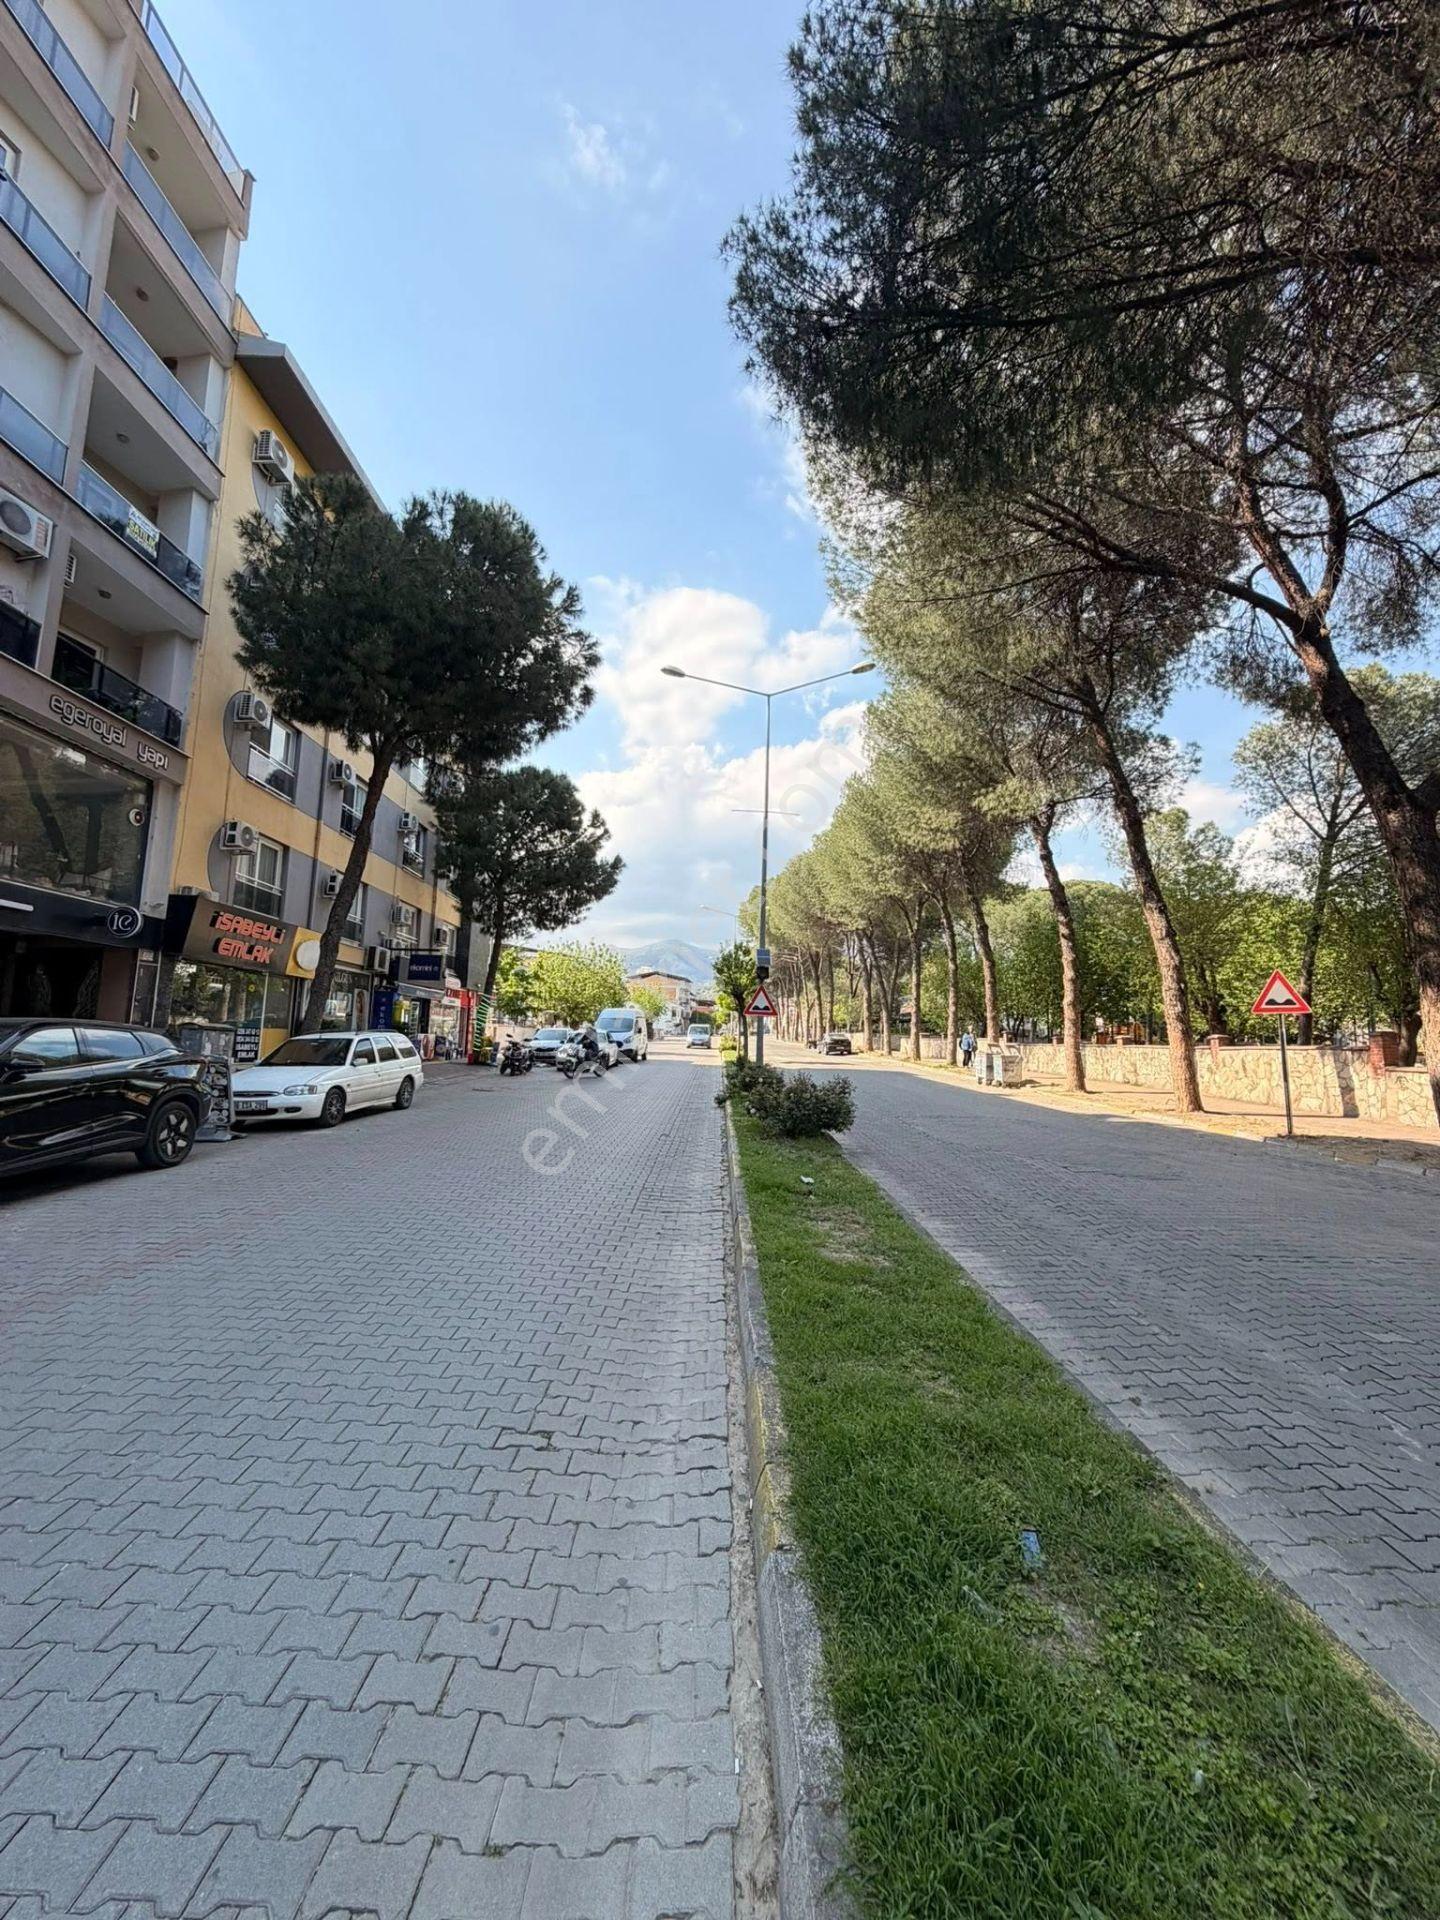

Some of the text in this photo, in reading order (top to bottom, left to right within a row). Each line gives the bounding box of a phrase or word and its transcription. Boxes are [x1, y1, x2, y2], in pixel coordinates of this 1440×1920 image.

[50, 695, 169, 769] egeroyal yapı
[217, 937, 275, 964] EMLAK
